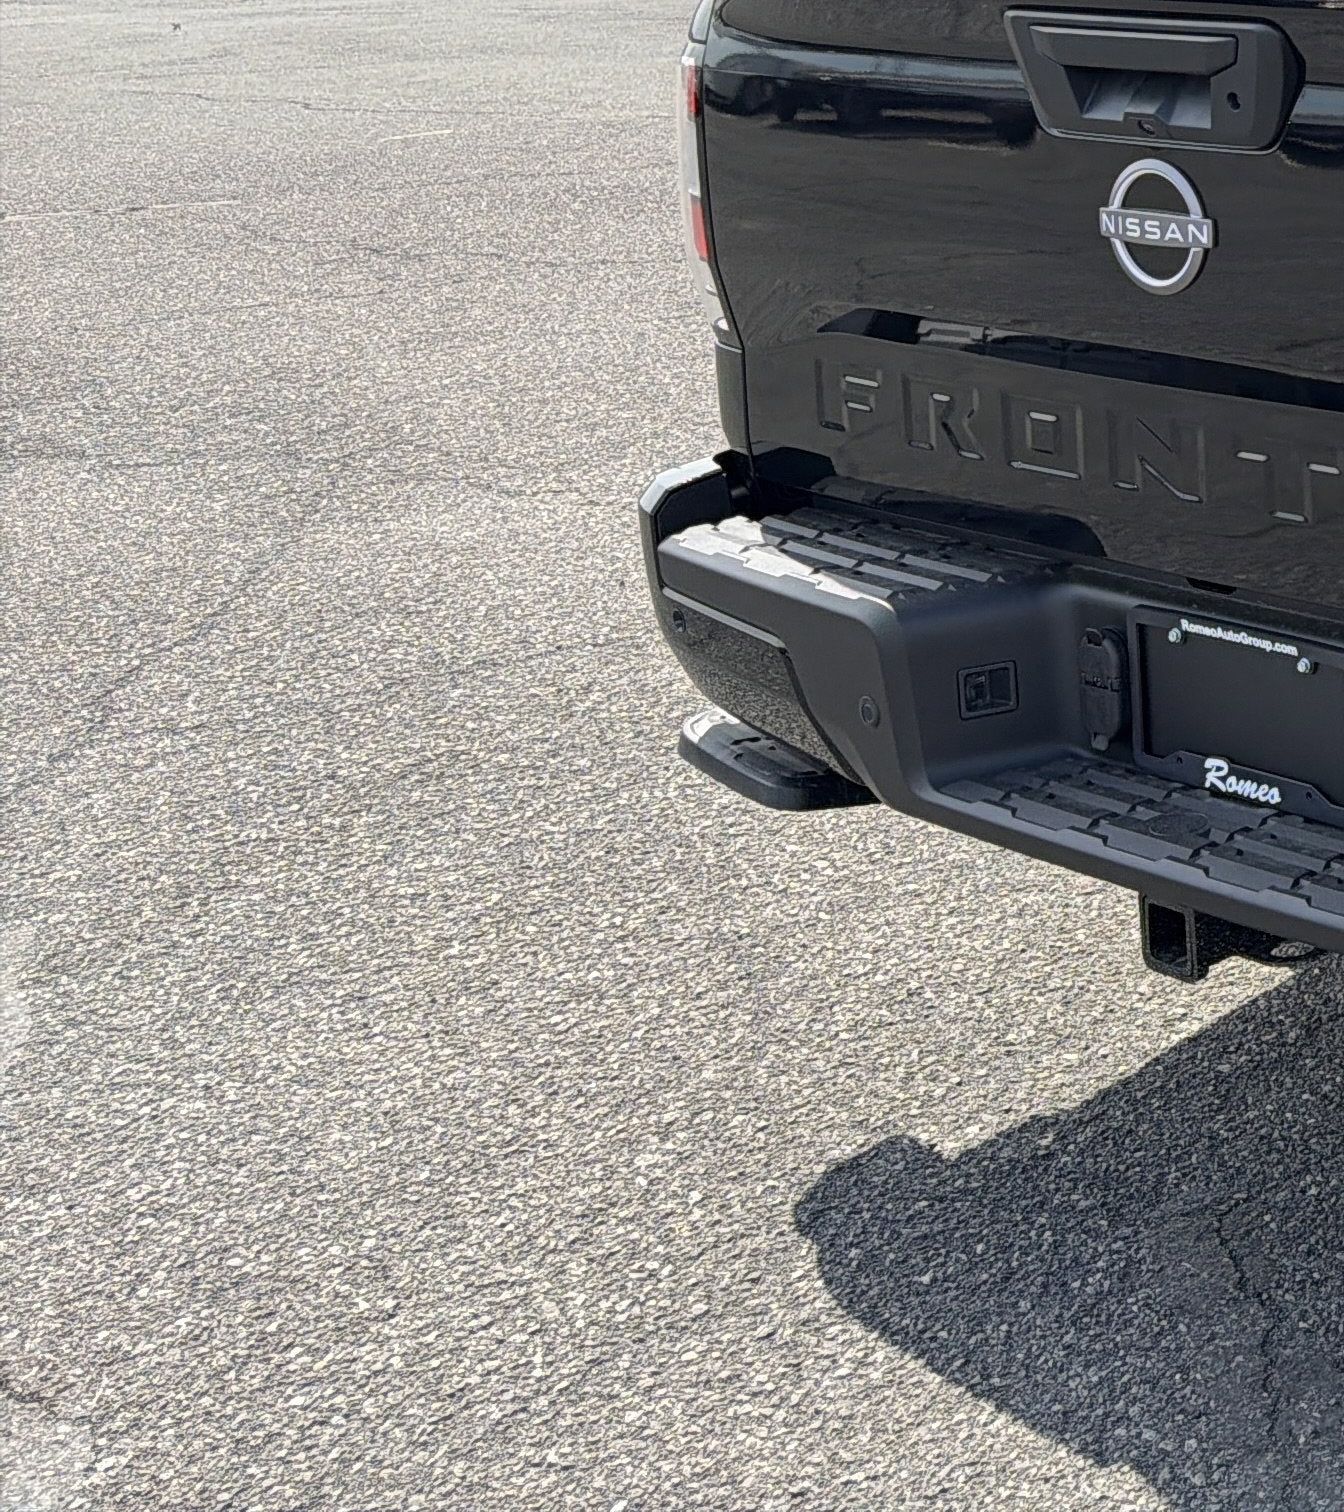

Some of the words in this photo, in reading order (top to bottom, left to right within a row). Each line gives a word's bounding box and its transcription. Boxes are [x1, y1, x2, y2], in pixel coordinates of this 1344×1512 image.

[1101, 211, 1208, 244] NISSAN
[1180, 618, 1299, 657] RomeoAutoGroup.com
[1203, 757, 1282, 806] Romeo
